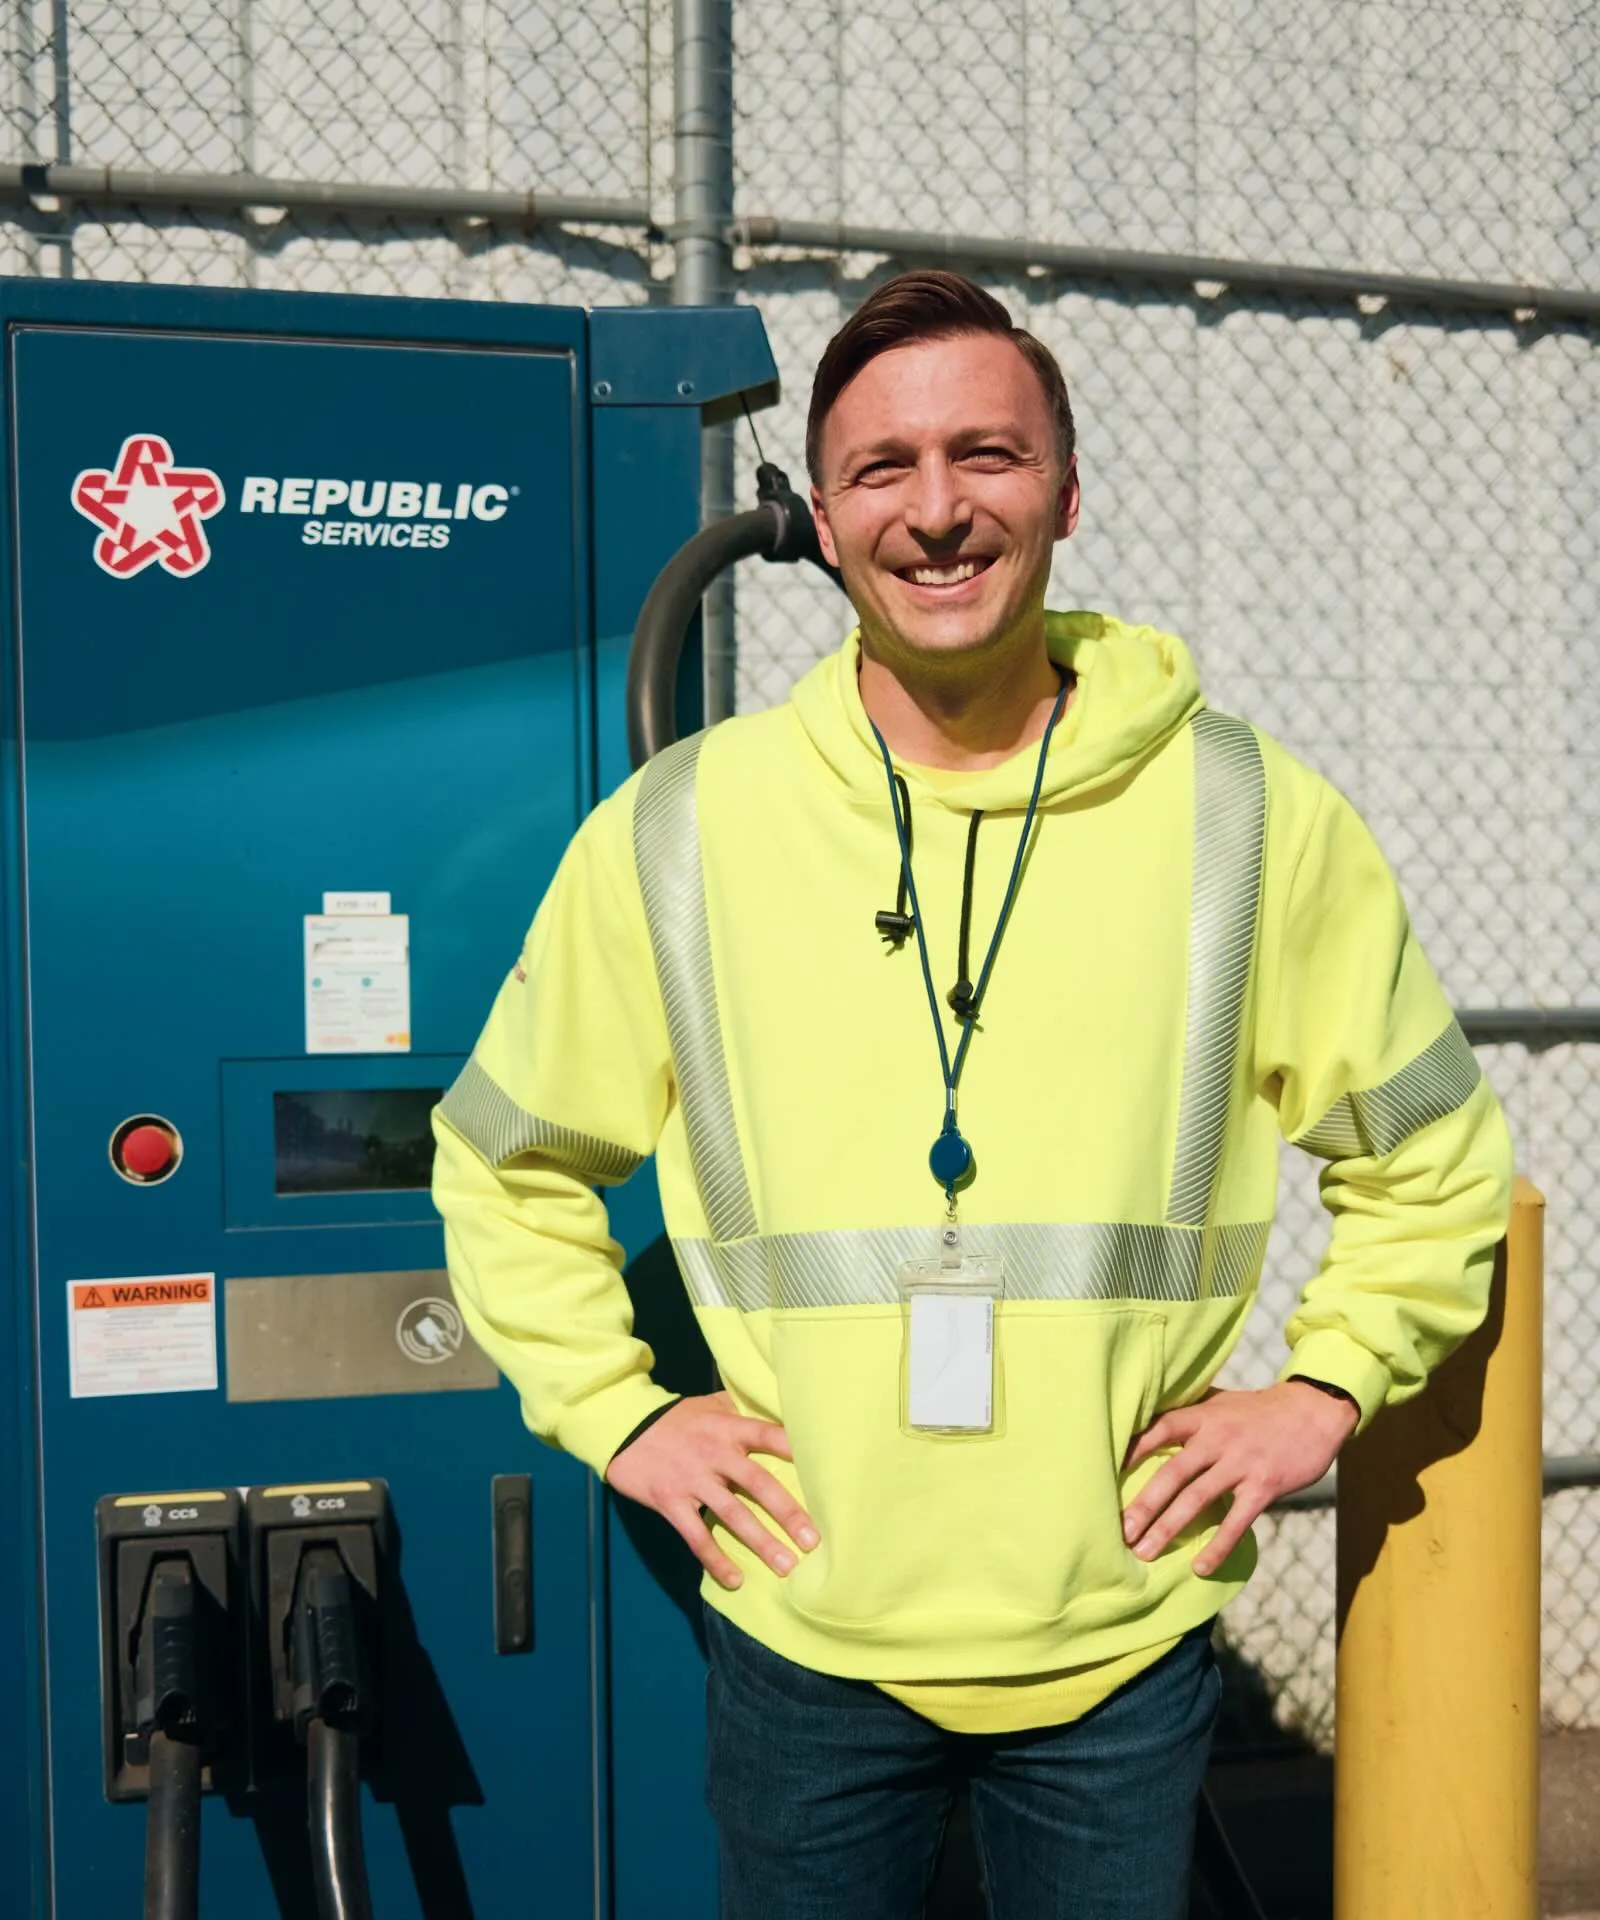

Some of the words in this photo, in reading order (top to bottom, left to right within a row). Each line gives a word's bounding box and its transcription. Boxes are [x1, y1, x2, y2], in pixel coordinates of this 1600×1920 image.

[240, 476, 508, 522] REPUBLIC
[301, 521, 450, 549] SERVICES
[112, 1283, 207, 1302] WARNING
